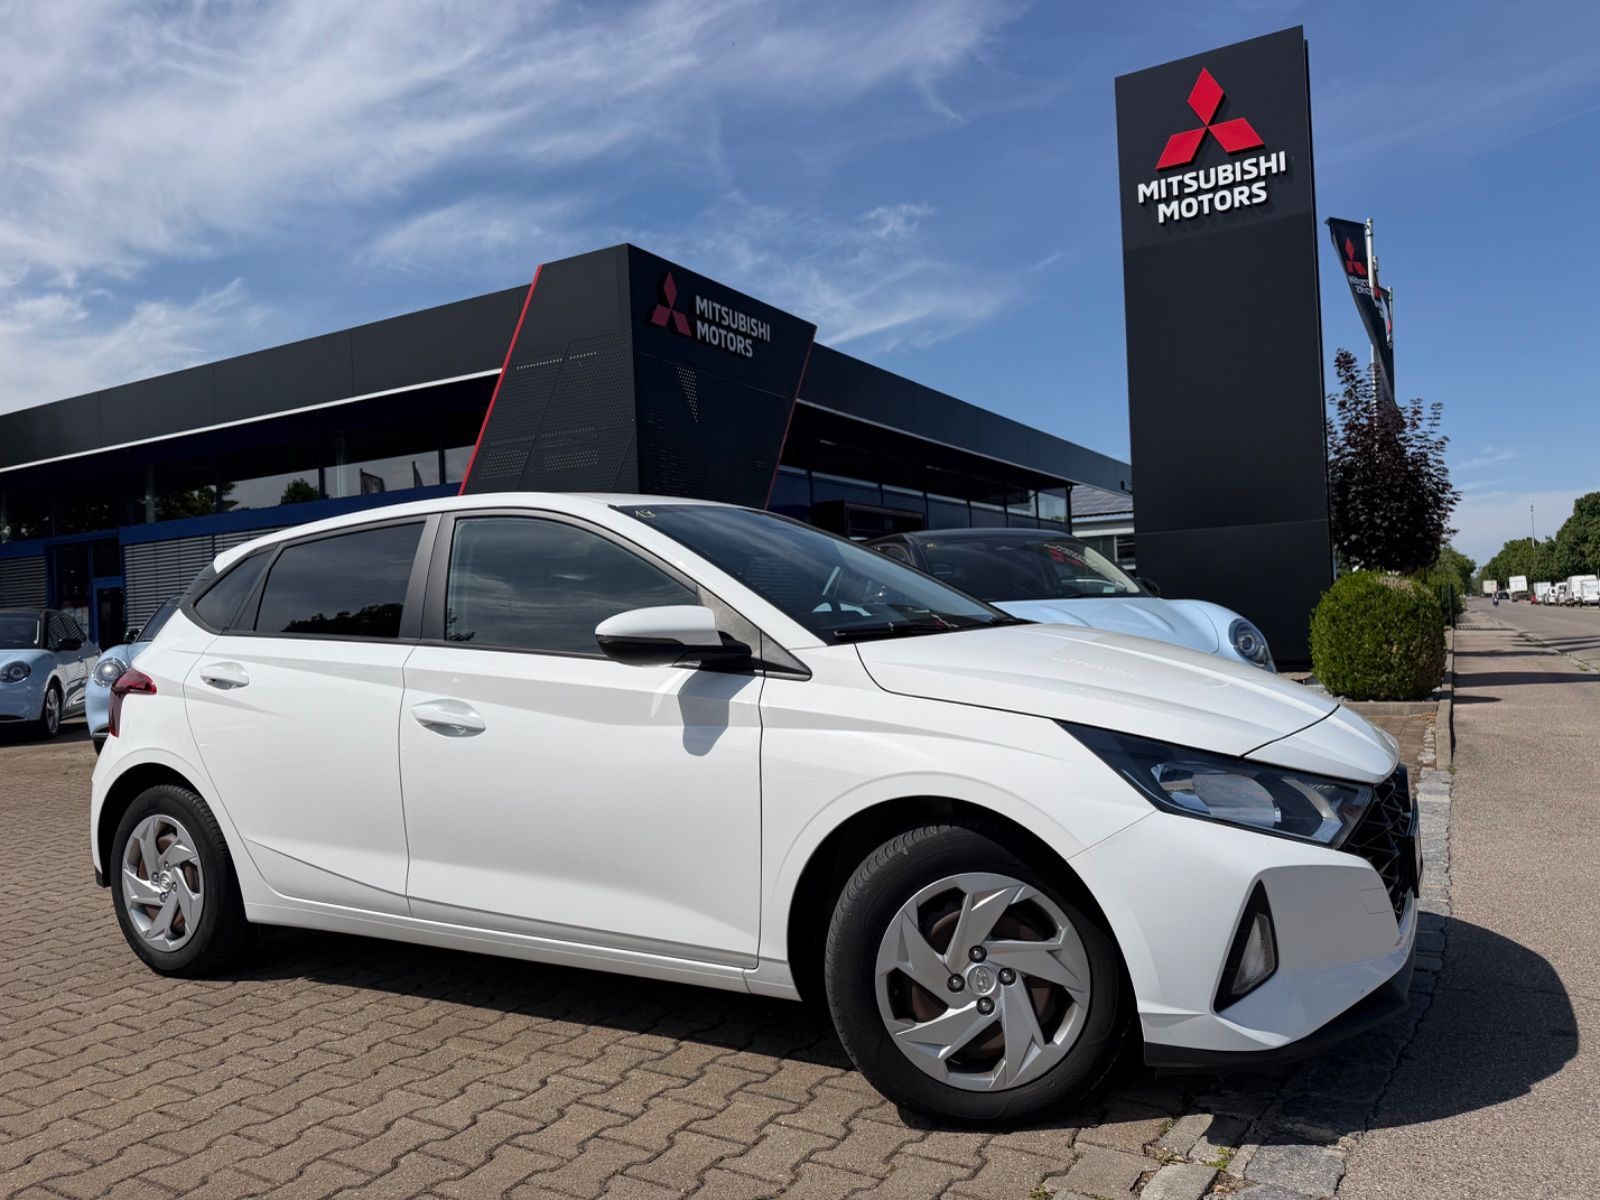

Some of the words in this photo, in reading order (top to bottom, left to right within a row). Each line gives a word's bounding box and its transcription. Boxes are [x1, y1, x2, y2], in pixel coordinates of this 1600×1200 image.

[1137, 151, 1286, 203] MITSUBISHI
[1157, 181, 1267, 223] MOTORS
[695, 295, 771, 342] MITSUBISHI
[696, 320, 753, 358] MOTORS
